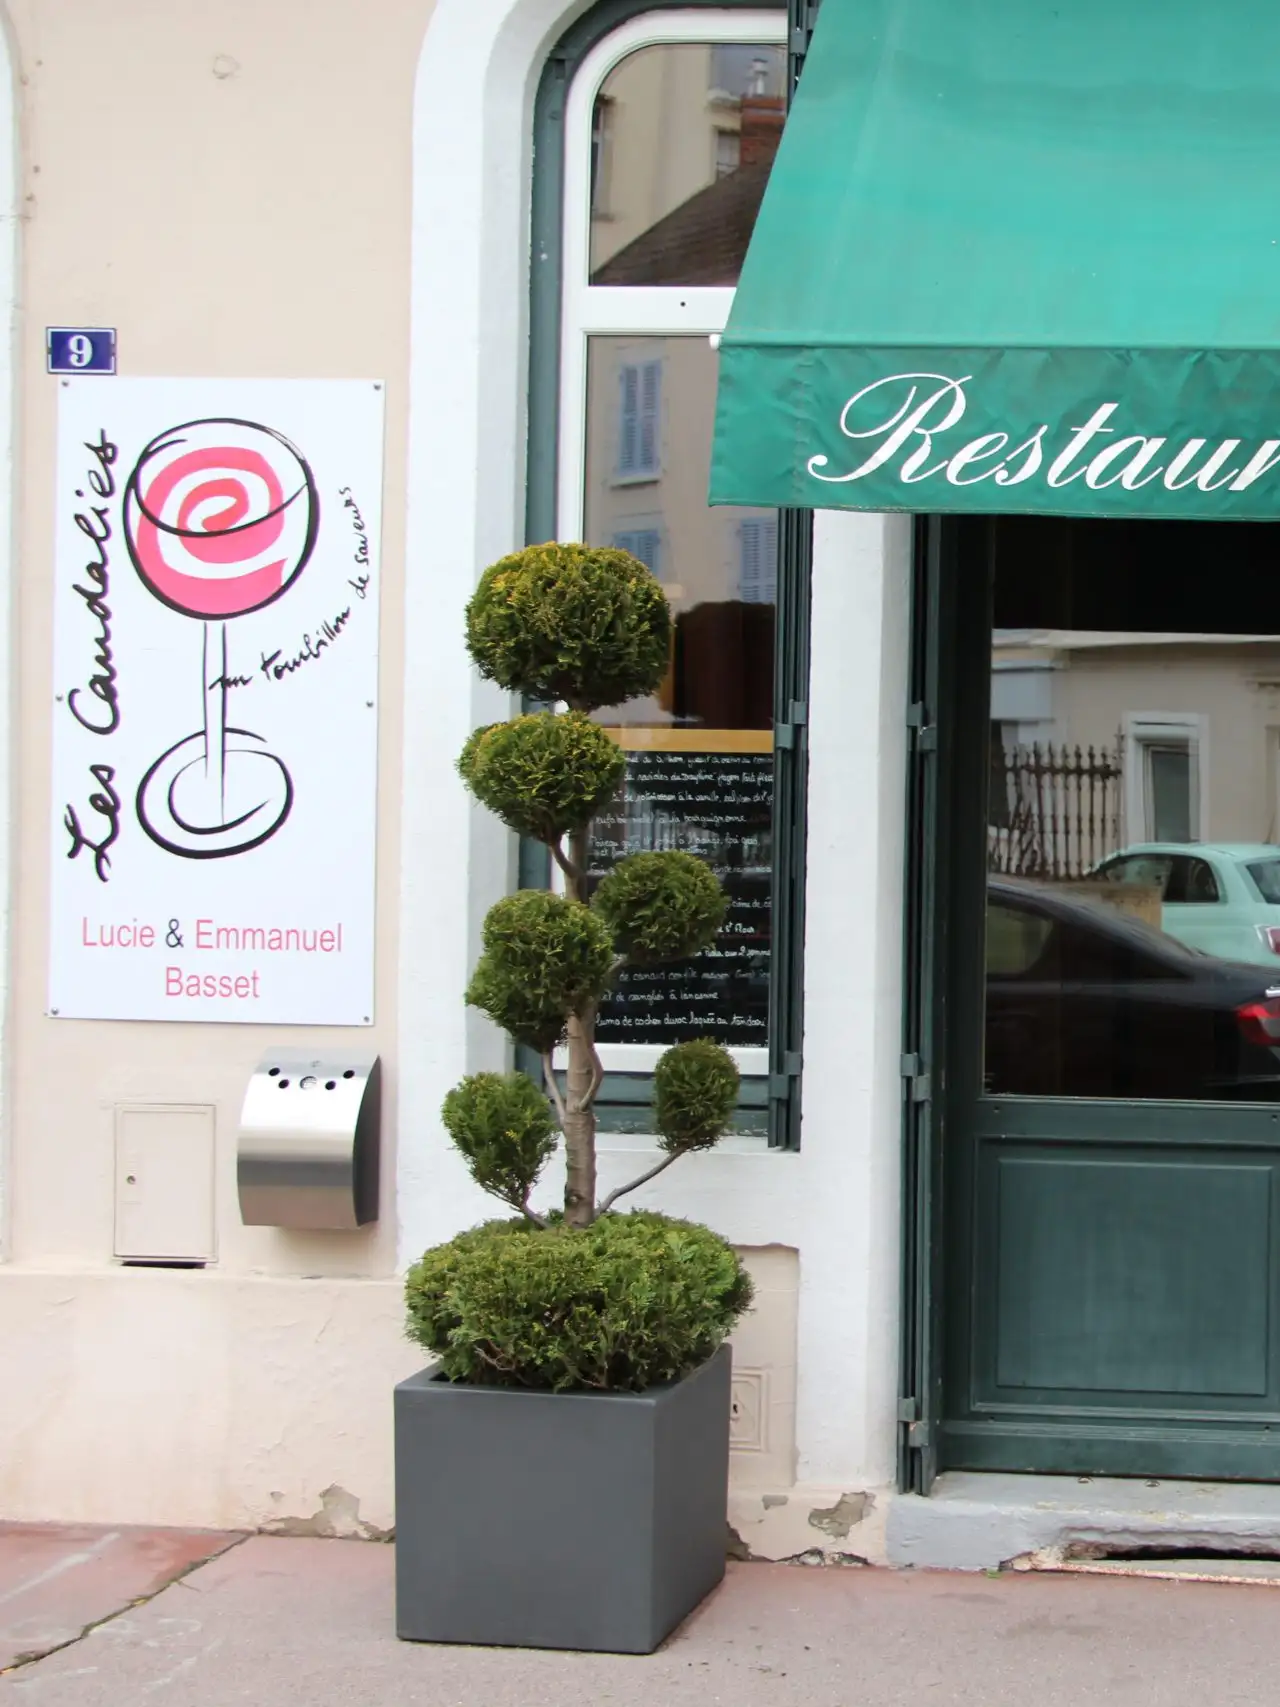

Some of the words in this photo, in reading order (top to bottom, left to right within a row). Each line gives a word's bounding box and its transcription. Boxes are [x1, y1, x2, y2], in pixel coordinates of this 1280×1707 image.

[68, 334, 93, 367] 9
[339, 486, 370, 566] saveurs
[67, 428, 121, 735] Caudalies
[348, 574, 370, 599] de
[261, 607, 351, 681] tourbillon
[64, 764, 121, 883] Les
[81, 916, 155, 948] Lucie
[164, 918, 184, 948] &
[194, 919, 343, 953] Emmanuel
[164, 966, 261, 998] Basset
